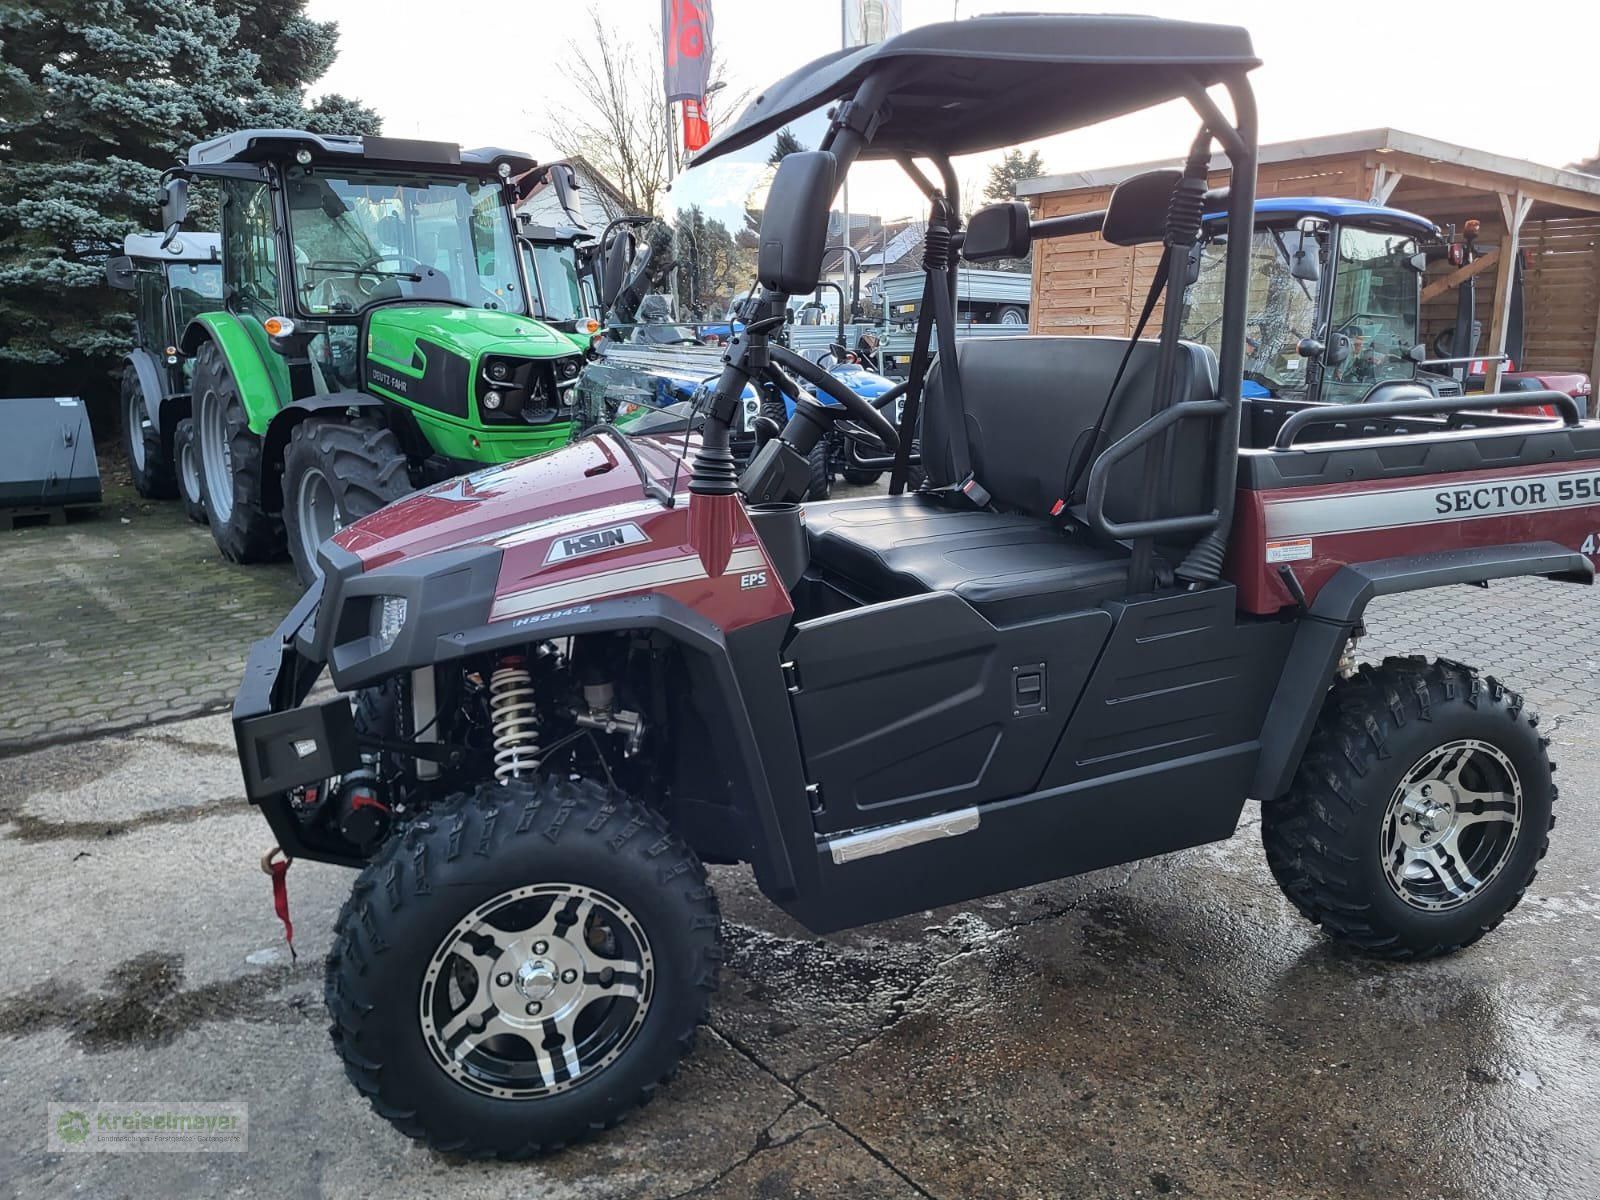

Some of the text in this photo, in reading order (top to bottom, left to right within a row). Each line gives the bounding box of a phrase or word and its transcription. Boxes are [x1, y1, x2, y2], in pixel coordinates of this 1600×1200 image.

[372, 369, 407, 392] DEUTZ-FAHR
[1435, 482, 1546, 515] SECTOR
[562, 528, 625, 556] HSUN
[741, 572, 766, 587] EPS
